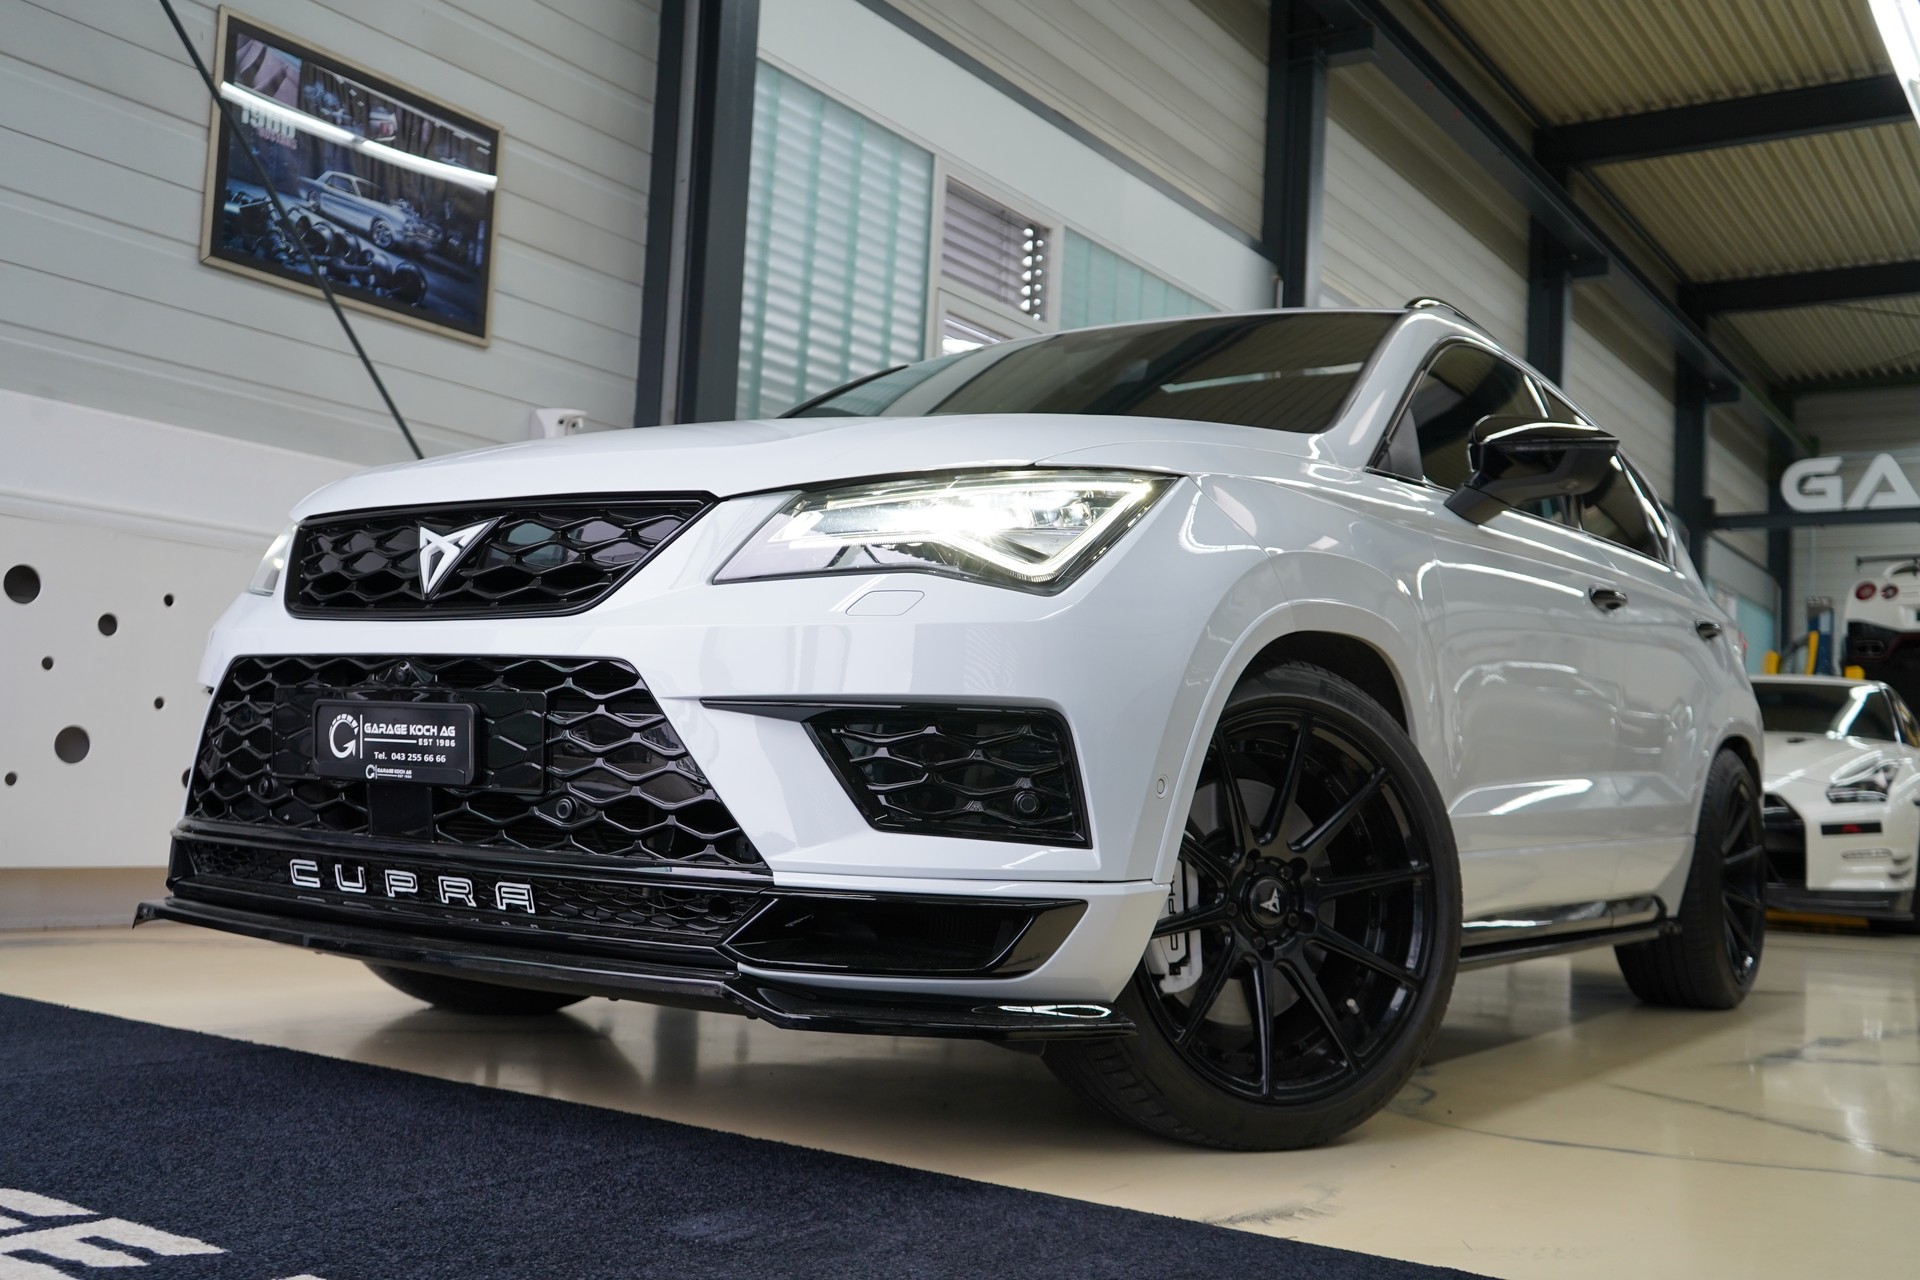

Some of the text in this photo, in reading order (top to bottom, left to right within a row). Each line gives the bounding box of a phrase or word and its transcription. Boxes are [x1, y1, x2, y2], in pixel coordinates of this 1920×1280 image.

[364, 723, 456, 737] GARAGE KOCH AG
[418, 738, 456, 747] EST 1986
[374, 751, 446, 763] Tel. 043 255 66 66
[290, 859, 535, 914] CUPRA
